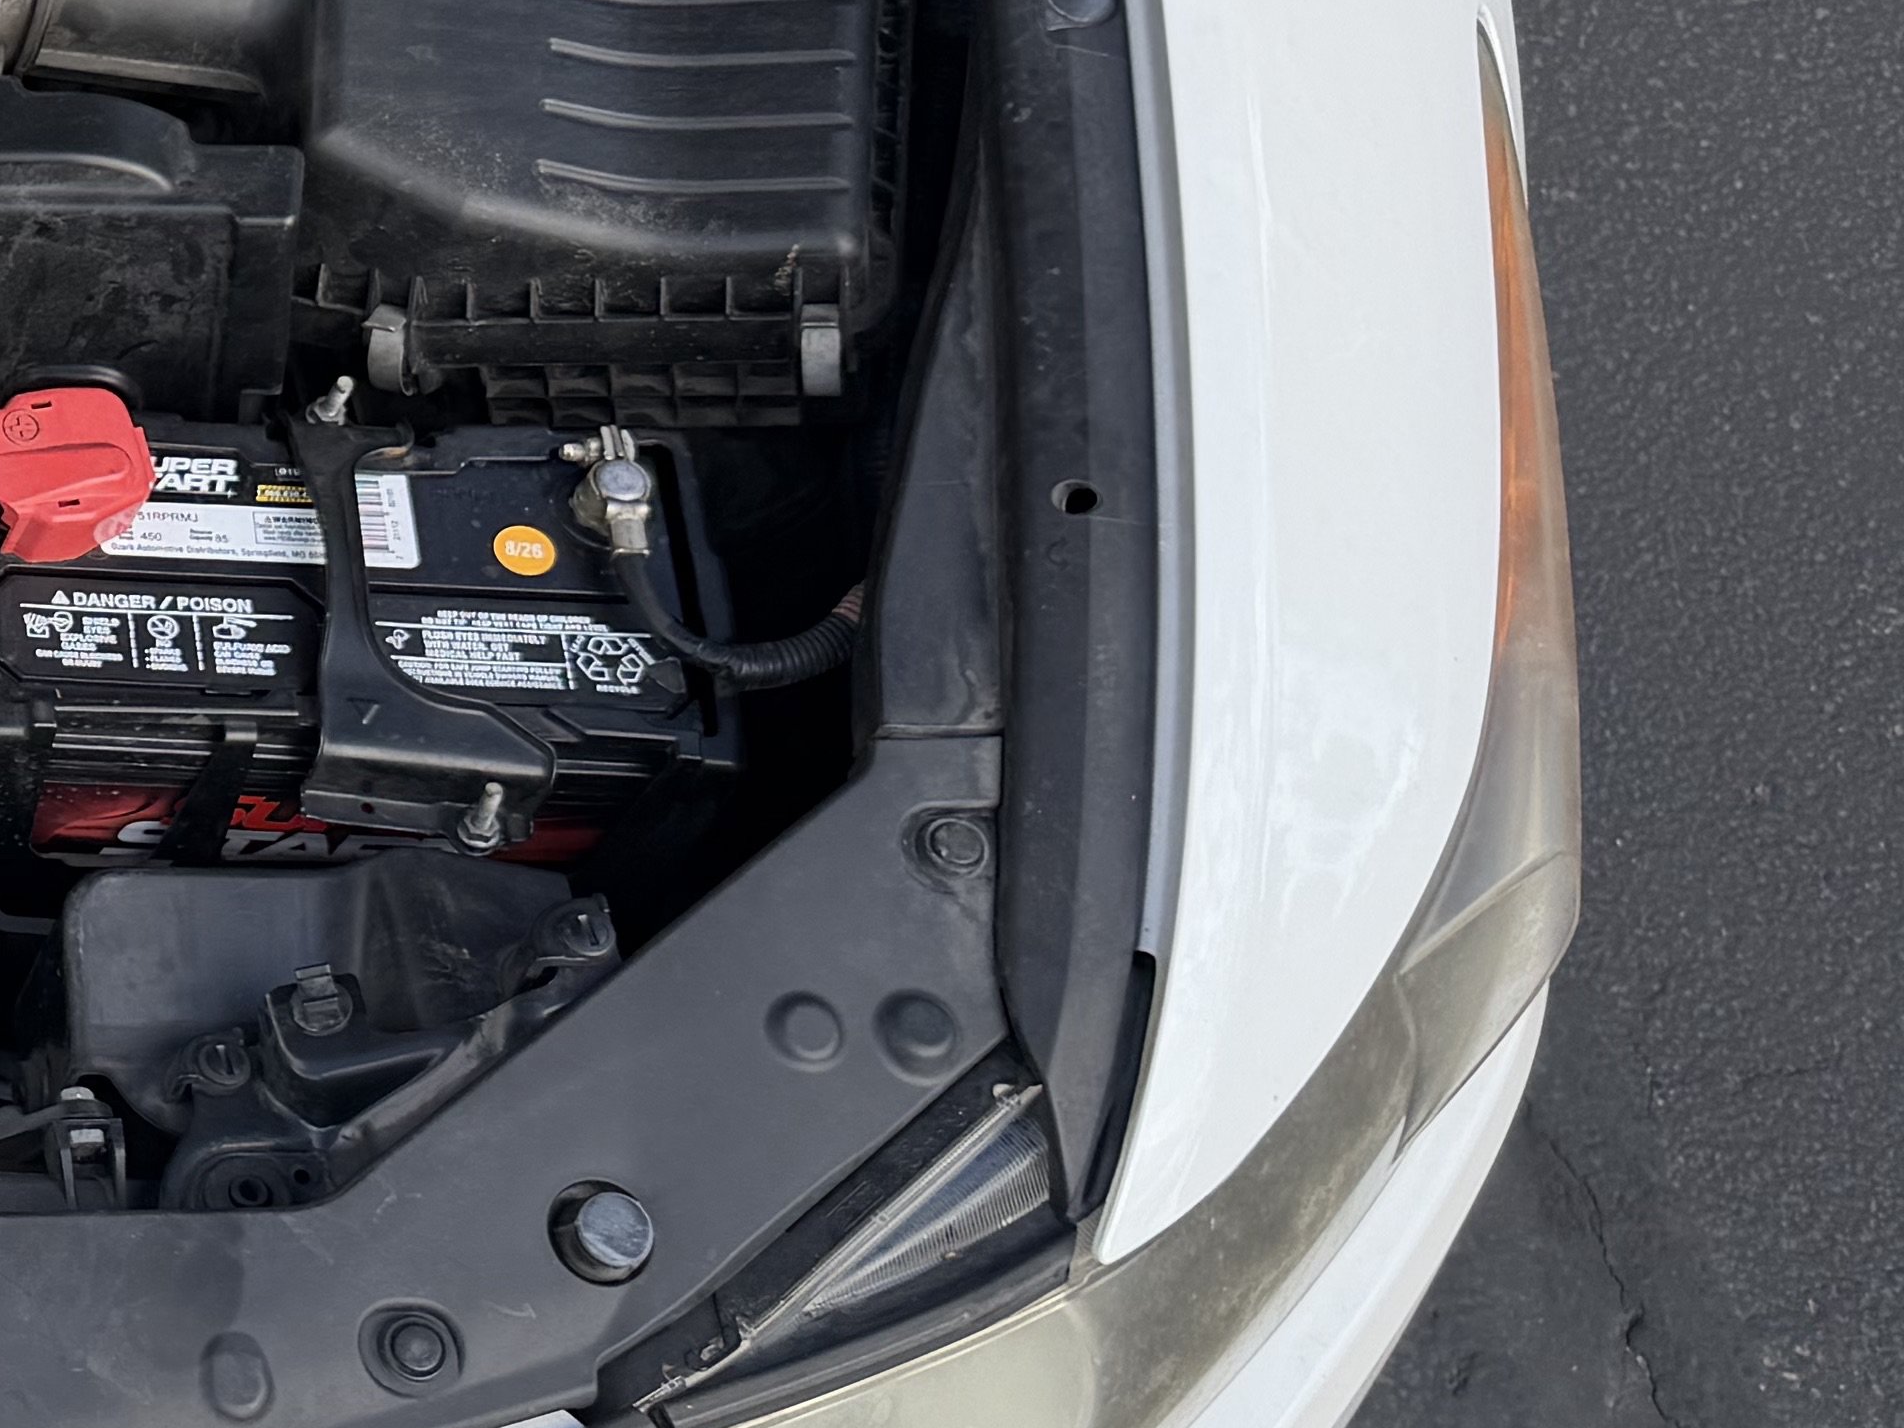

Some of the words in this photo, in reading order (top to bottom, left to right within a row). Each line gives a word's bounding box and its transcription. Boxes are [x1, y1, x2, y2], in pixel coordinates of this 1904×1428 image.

[152, 456, 237, 476] UPER
[149, 473, 240, 493] ART
[505, 540, 543, 559] 8/26
[73, 591, 156, 610] DANGER
[177, 595, 254, 614] POISON
